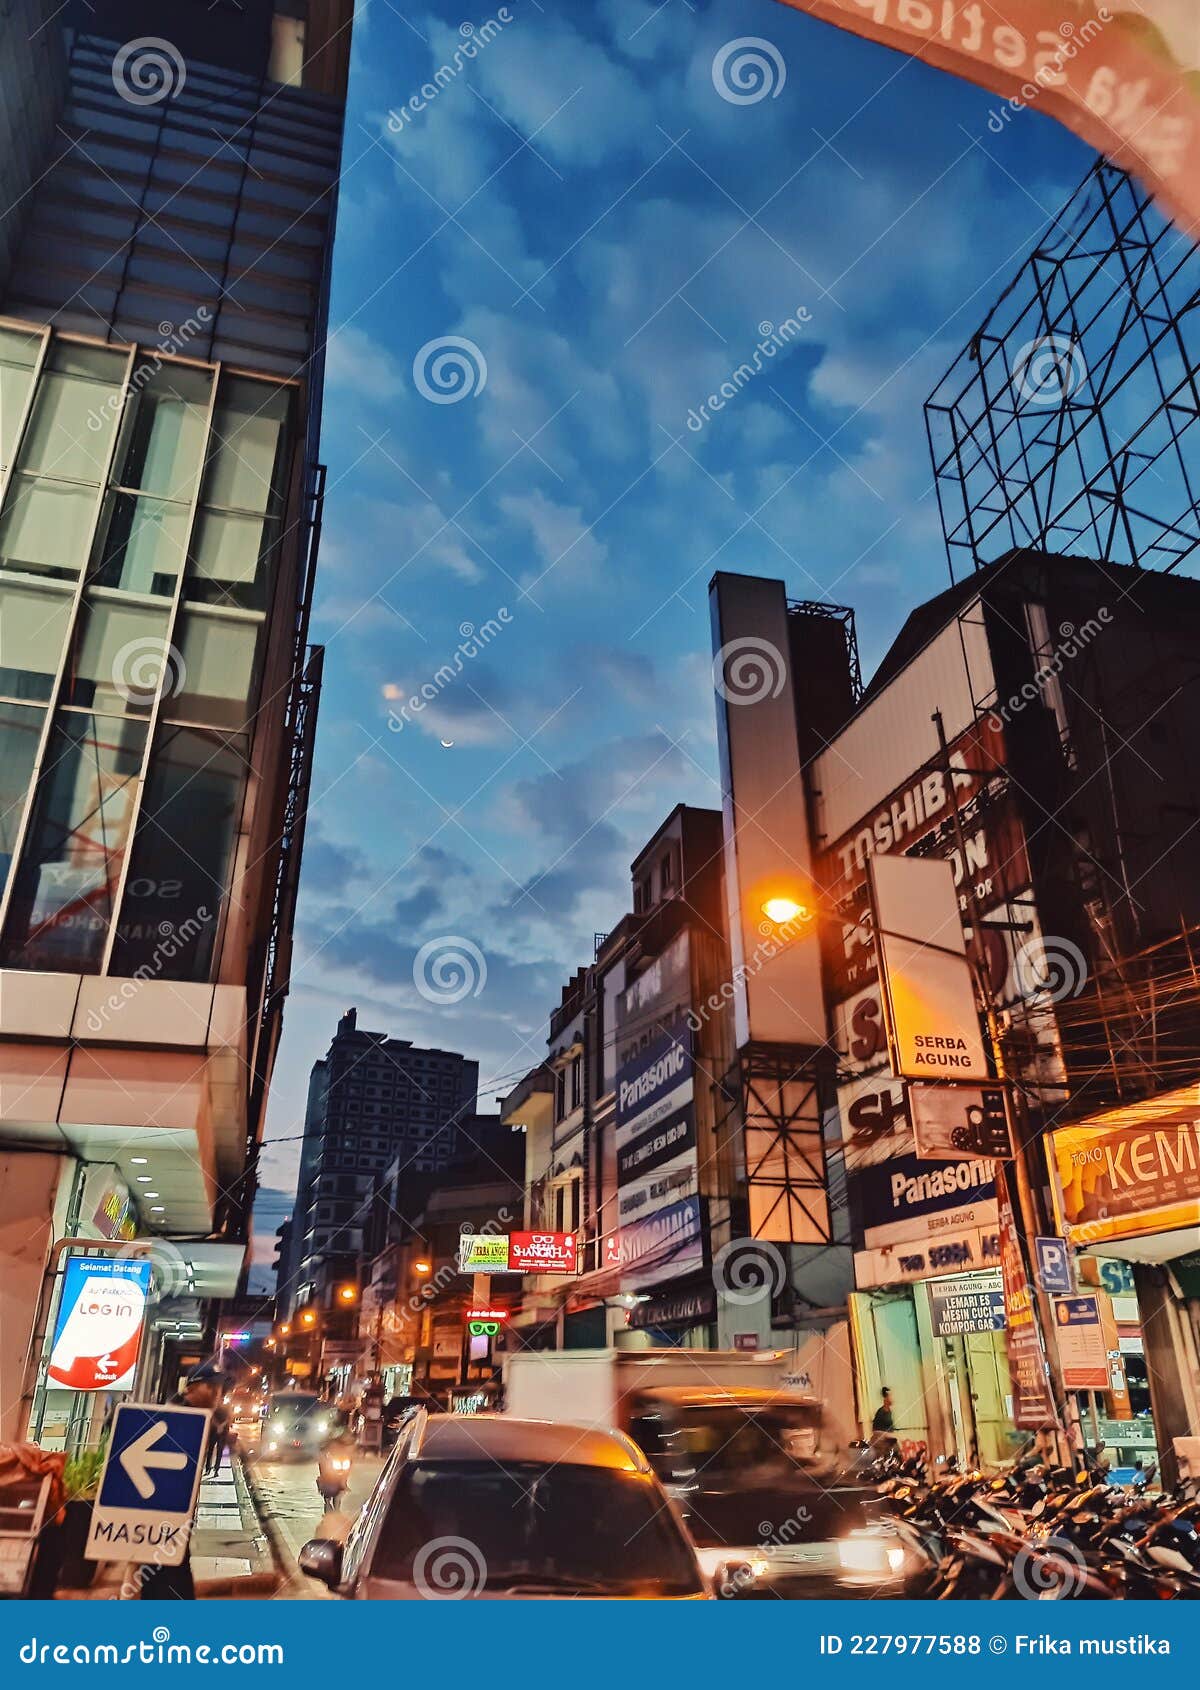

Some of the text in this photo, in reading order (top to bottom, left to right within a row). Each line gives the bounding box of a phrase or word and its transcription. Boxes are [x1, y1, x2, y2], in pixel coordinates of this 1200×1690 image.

[838, 750, 973, 880] TOSHIBA
[915, 1035, 967, 1050] SERBA
[915, 1052, 972, 1068] AGUNG
[620, 1040, 685, 1113] Panasonic
[1072, 1147, 1103, 1167] TOKO
[927, 1210, 975, 1231] SERBA AGUNG
[1042, 1245, 1062, 1274] P
[80, 1262, 142, 1275] Selamat Datang
[958, 1282, 983, 1291] AGUNG
[79, 1302, 112, 1317] LOG
[945, 1294, 991, 1309] LEMARI ES
[942, 1305, 993, 1322] MESIN CUCI
[939, 1319, 976, 1335] KOMPOR
[977, 1317, 994, 1331] GAS
[94, 1371, 118, 1381] Masuk
[94, 1521, 181, 1547] MASUK
